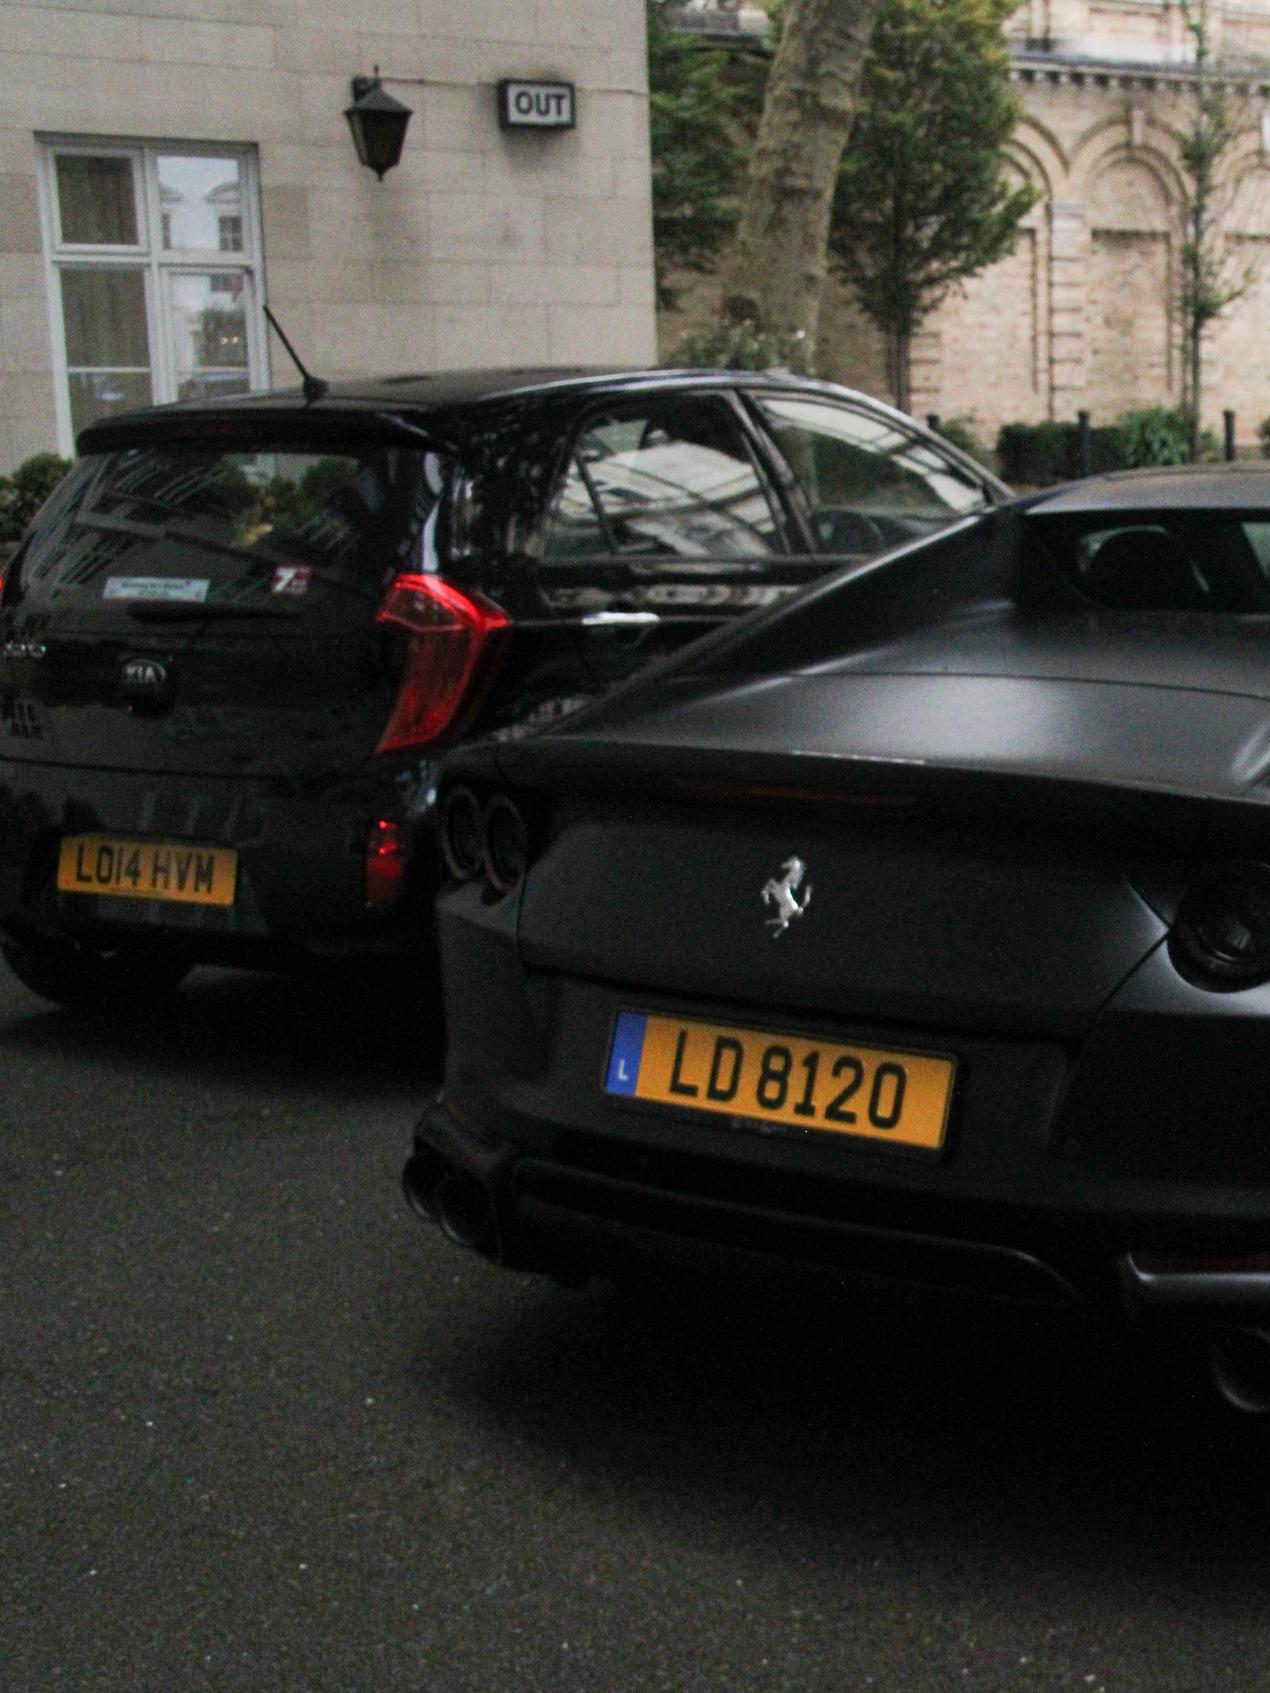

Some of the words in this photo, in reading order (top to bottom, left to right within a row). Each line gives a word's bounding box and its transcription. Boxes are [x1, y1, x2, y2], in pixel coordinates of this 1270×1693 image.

[515, 90, 567, 116] OUT
[76, 843, 142, 887] LO14
[152, 849, 216, 894] HVM
[618, 1059, 630, 1082] L
[669, 1029, 744, 1103] LD
[756, 1045, 908, 1130] 8120
